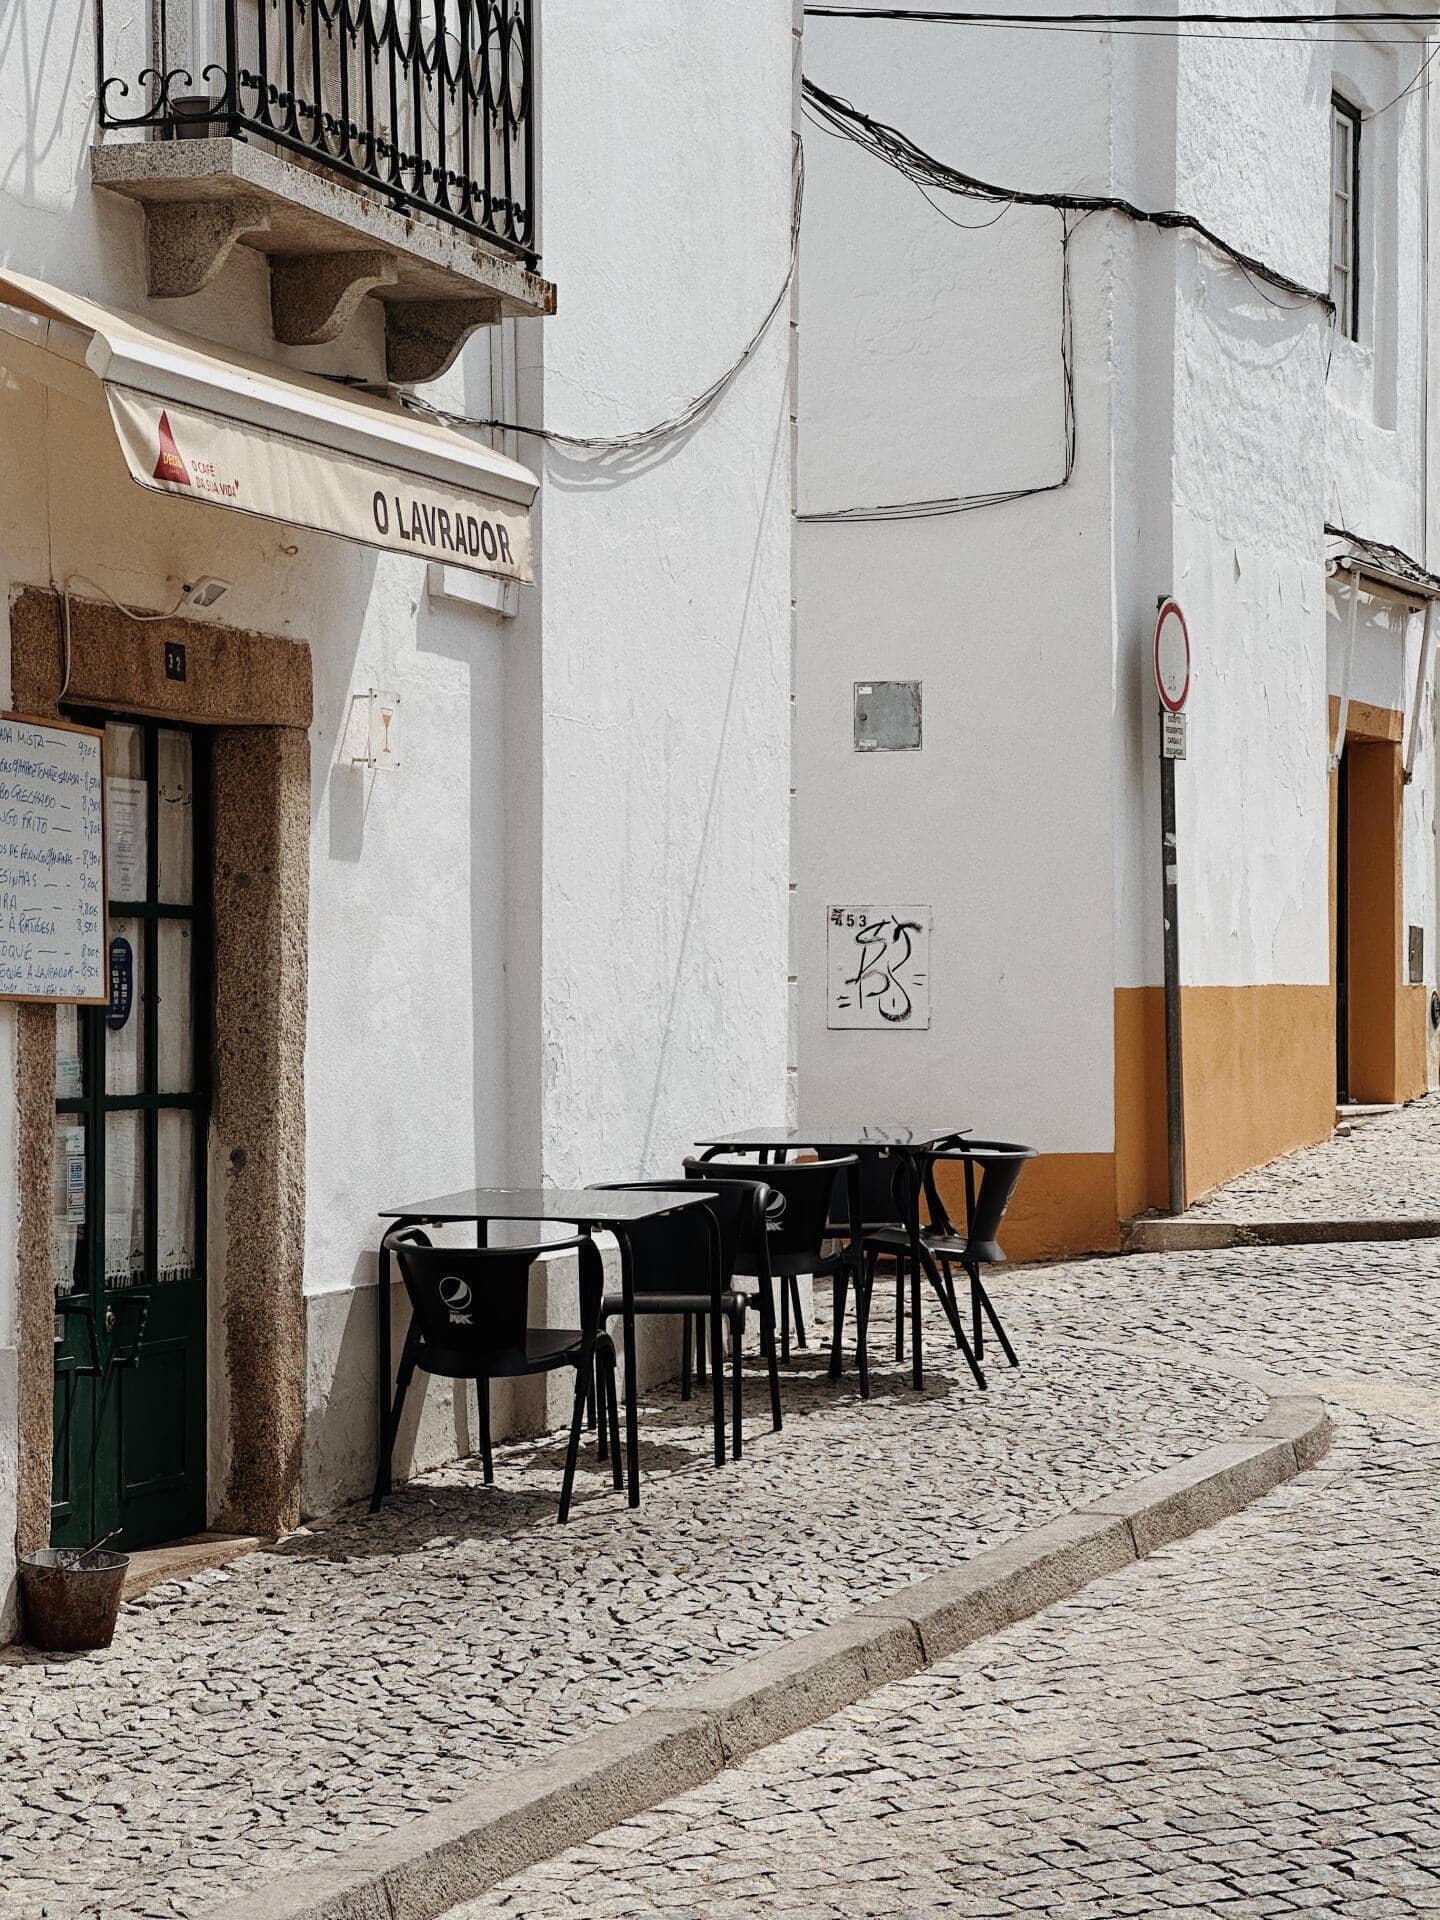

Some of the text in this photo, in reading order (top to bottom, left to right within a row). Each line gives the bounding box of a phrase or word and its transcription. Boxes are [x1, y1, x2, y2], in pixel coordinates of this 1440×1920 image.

[192, 460, 198, 472] O
[220, 482, 236, 498] VIDA
[373, 491, 515, 565] O LAVRADOR
[22, 811, 48, 834] FRITO
